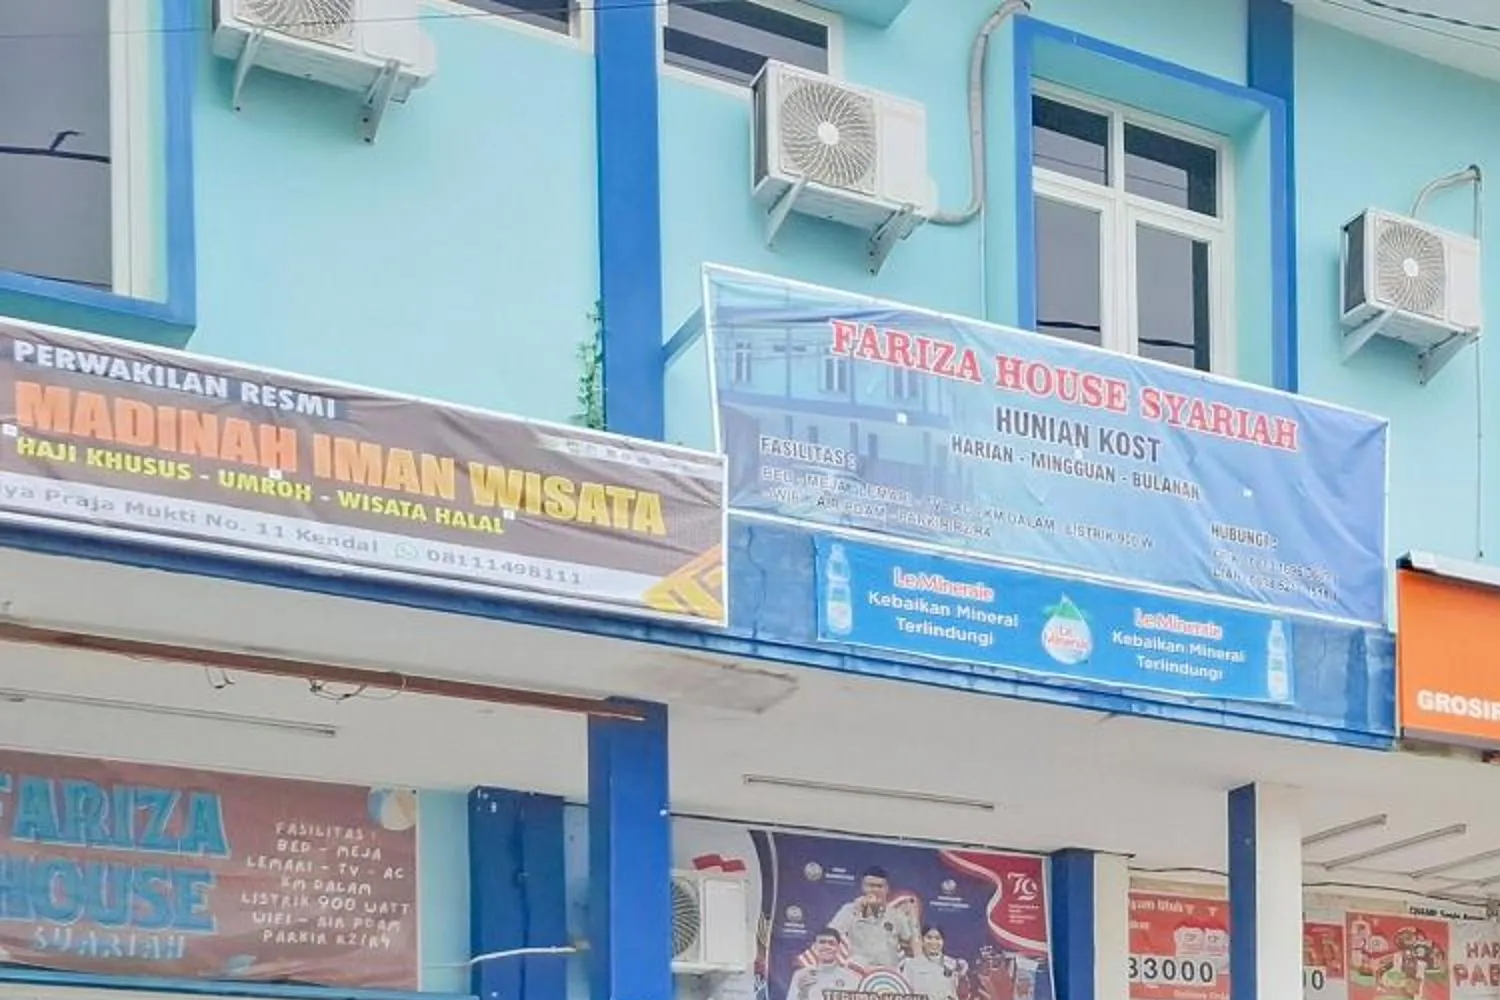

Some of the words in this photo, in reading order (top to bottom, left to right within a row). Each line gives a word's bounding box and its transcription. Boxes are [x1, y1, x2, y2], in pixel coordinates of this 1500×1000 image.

[13, 339, 228, 399] PERWAKILAN
[241, 380, 336, 419] RESMI
[831, 320, 983, 384] FARIZA
[995, 355, 1128, 413] HOUSE
[1140, 386, 1299, 451] SYARIAH
[15, 381, 297, 473] MADINAH
[313, 433, 455, 500] IMAN
[468, 461, 667, 536] WISATA
[995, 406, 1091, 449] HUNIAN
[1098, 425, 1161, 464] KOST
[17, 436, 77, 463] HAJI
[86, 447, 192, 481] KHUSUS
[218, 469, 312, 502] UMROH
[338, 489, 427, 522] WISATA
[435, 507, 505, 534] HALAL
[951, 435, 1014, 464] HARIAN
[1030, 450, 1116, 484] MINGGUAN
[1131, 470, 1201, 502] BULANAN
[44, 487, 115, 513] Praja
[125, 501, 196, 523] Mukti
[205, 513, 247, 533] No.
[257, 522, 286, 540] 11
[297, 529, 379, 554] Kendal
[426, 547, 582, 585] 08111498111
[867, 591, 951, 618] Kebaikan
[955, 604, 1019, 629] Mineral
[895, 616, 993, 648] Terlindungi
[1111, 630, 1185, 655] Kebaikan
[1187, 642, 1246, 663] Mineral
[1136, 653, 1224, 682] Terlindungi
[337, 845, 382, 861] MEJA
[317, 895, 357, 911] 900
